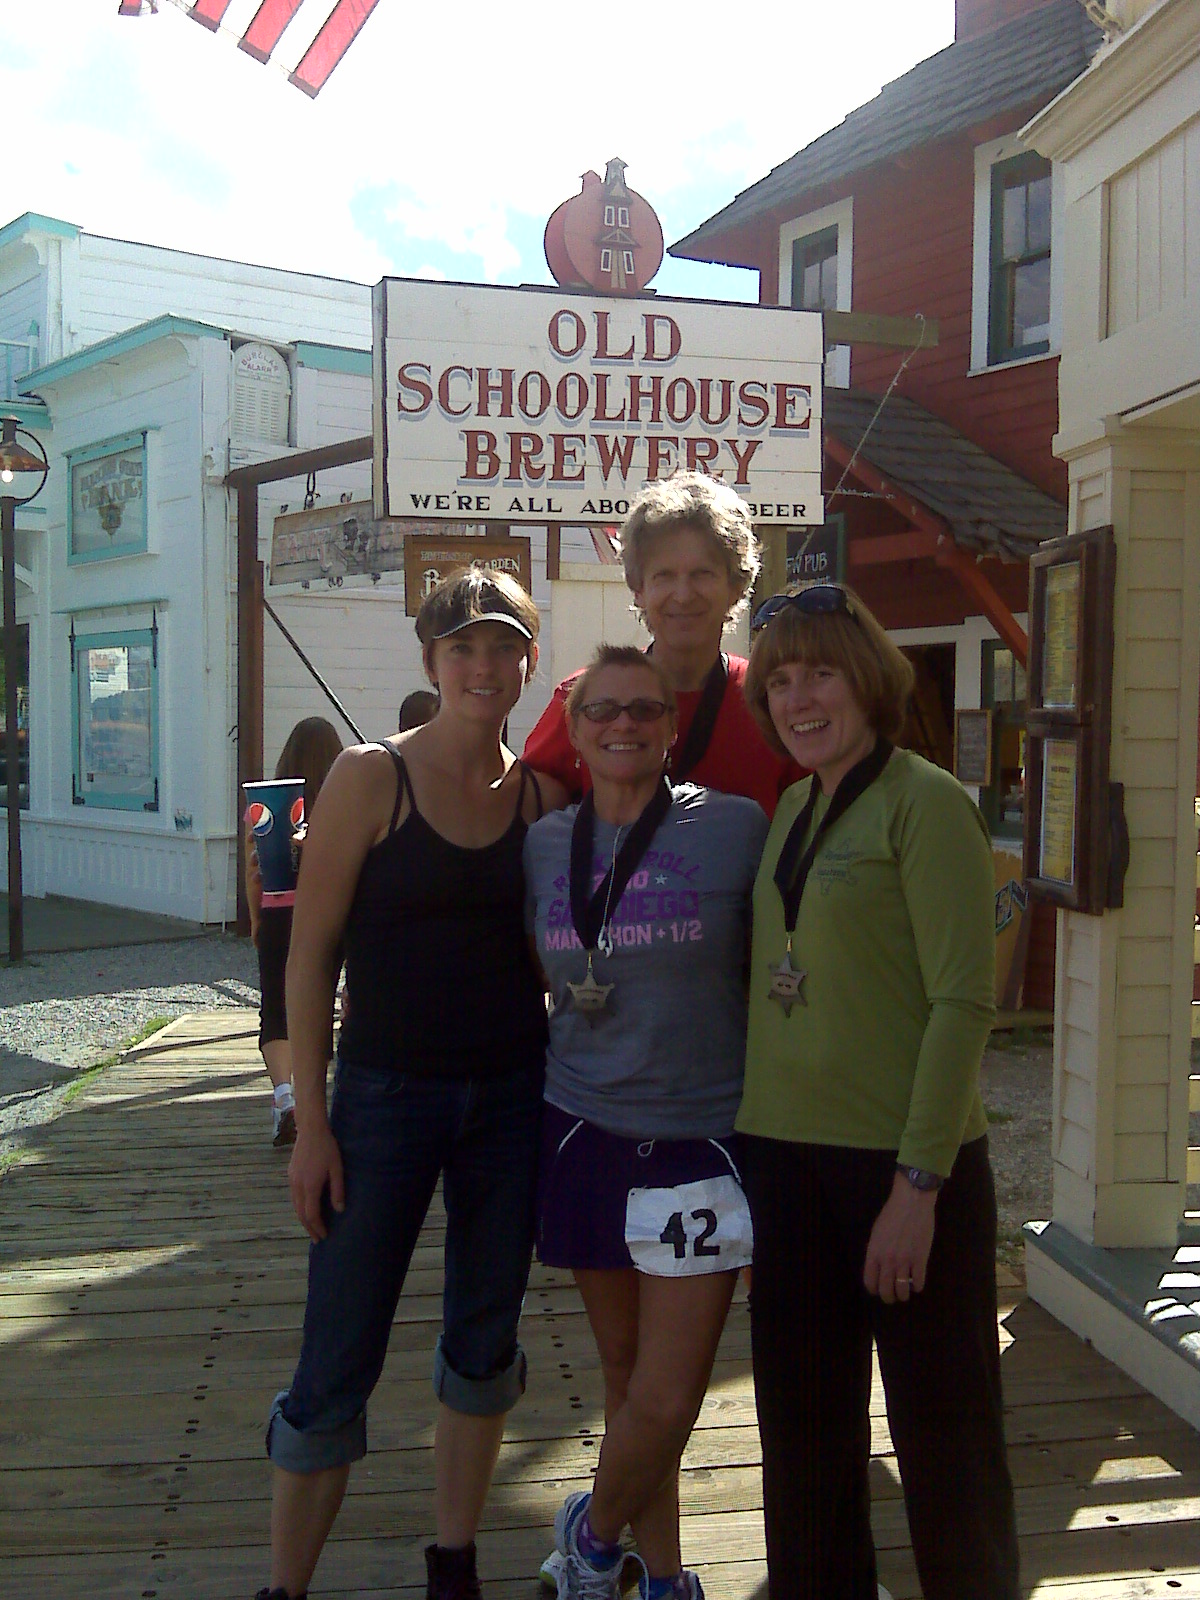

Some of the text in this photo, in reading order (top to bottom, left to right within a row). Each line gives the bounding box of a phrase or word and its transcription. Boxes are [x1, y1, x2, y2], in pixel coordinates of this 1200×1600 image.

[547, 309, 682, 363] OLD
[397, 361, 811, 434] SCHOOLHOUSE
[458, 429, 763, 490] BREWERY
[410, 489, 806, 517] WE'RE ALL ABO BEER
[670, 919, 704, 943] 1/2
[660, 1208, 720, 1259] 42
